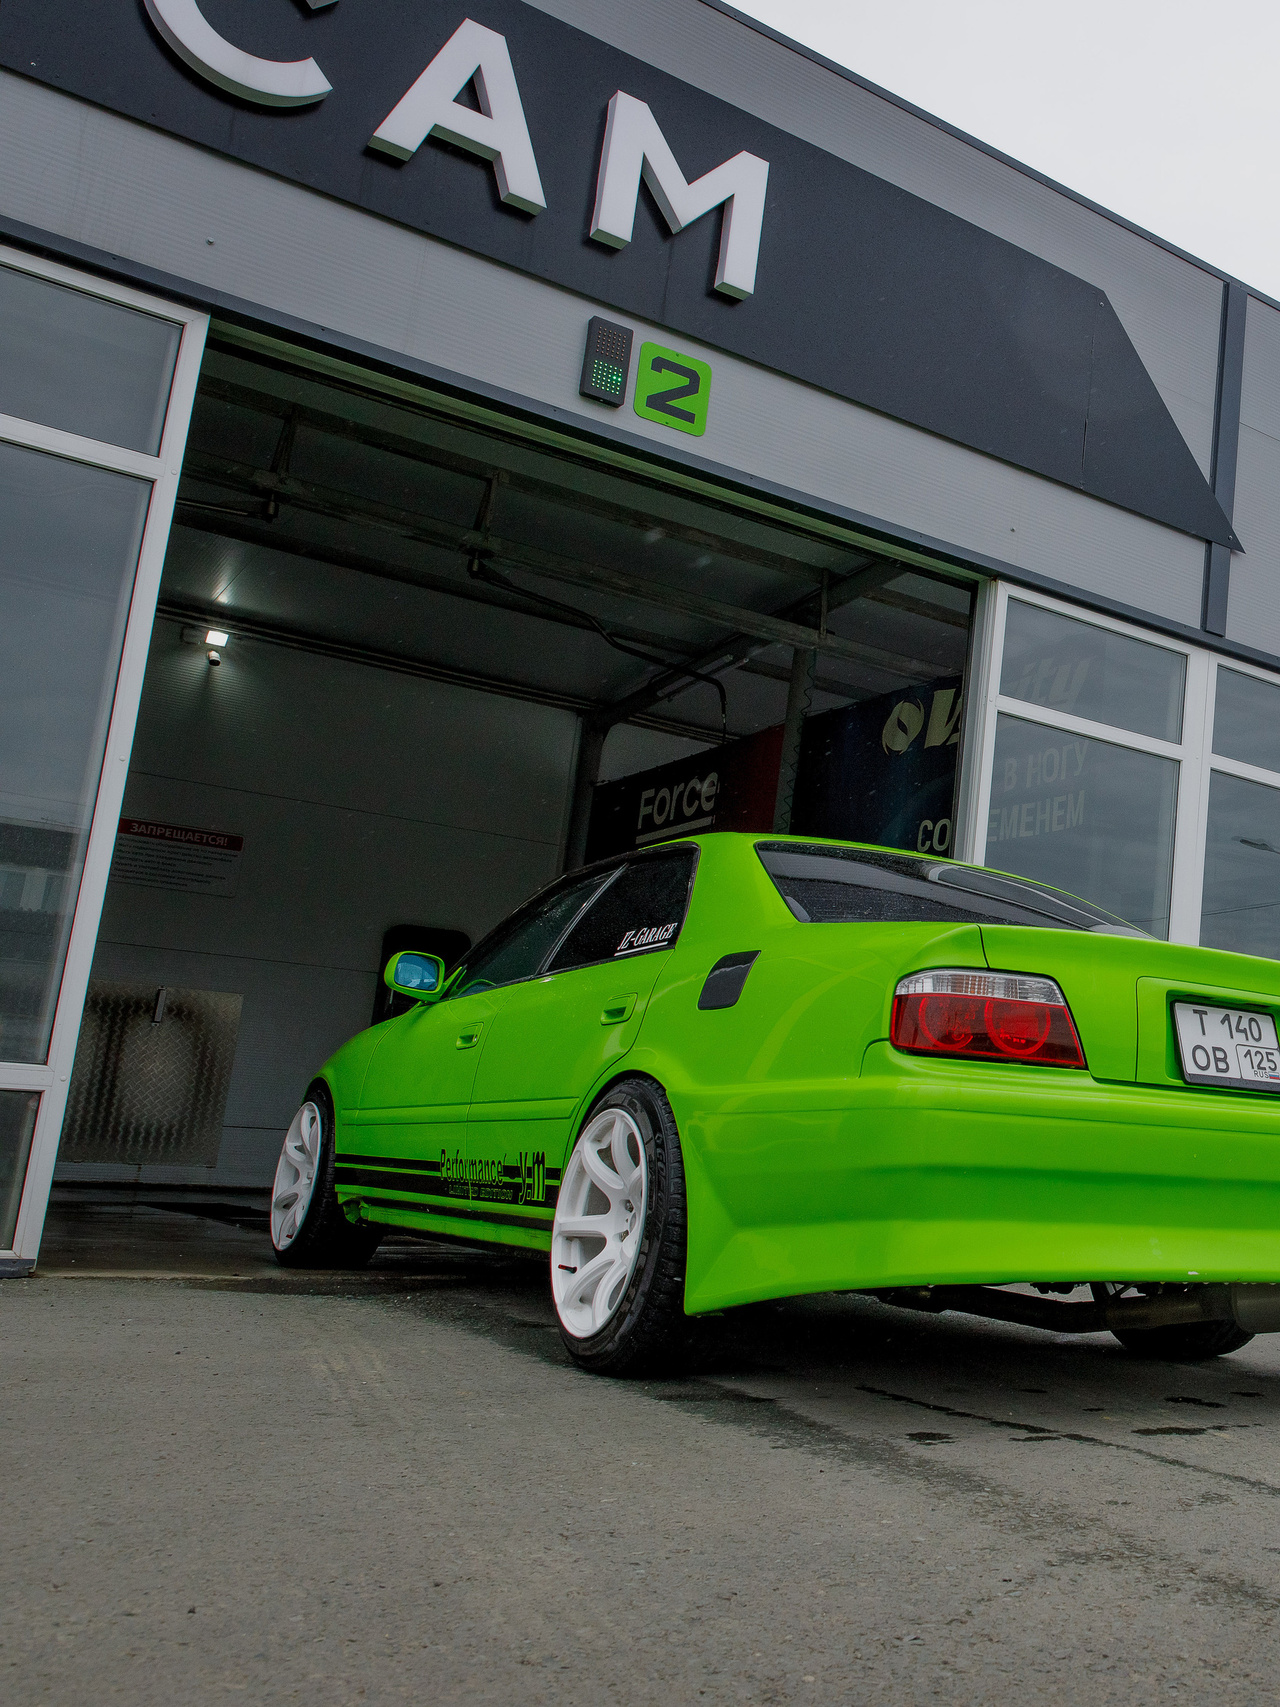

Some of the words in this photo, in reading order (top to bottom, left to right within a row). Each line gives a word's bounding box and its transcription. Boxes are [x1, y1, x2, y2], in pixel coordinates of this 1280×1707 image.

[644, 355, 703, 425] 2
[1026, 740, 1089, 788] НОГУ
[637, 771, 719, 830] Force
[987, 790, 1085, 842] ЕМЕНЕМ
[130, 822, 228, 846] ЗАПРЕЩАЕТСЯ!
[1192, 1008, 1208, 1036] Т
[1220, 1013, 1262, 1042] 140
[1191, 1044, 1230, 1073] ОВ
[1243, 1049, 1278, 1071] 125
[1253, 1070, 1269, 1079] RUS
